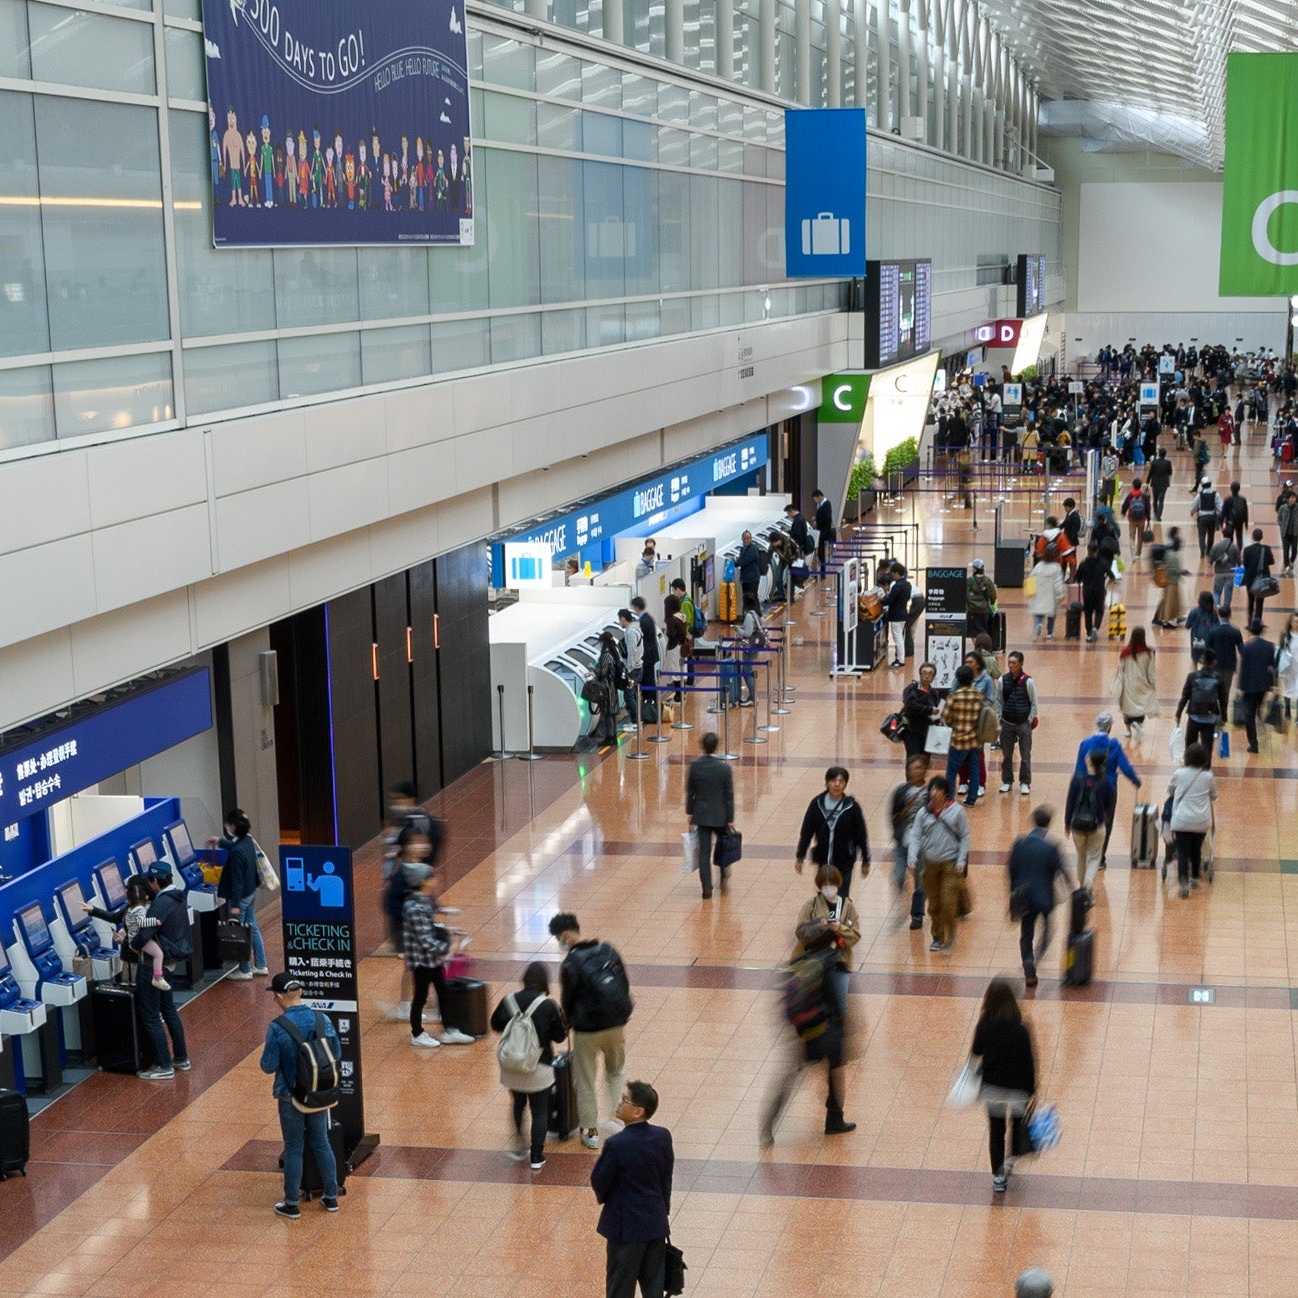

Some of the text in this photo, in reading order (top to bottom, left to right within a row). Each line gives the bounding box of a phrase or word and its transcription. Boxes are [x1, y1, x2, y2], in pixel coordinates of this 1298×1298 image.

[285, 31, 315, 78] DAYS
[319, 52, 335, 81] TO
[338, 29, 365, 77] GO!
[405, 58, 421, 75] HELLO
[1000, 326, 1014, 341] D
[833, 385, 852, 411] C
[640, 483, 664, 516] BAGGAGE
[928, 570, 964, 578] BAGGAGE
[286, 923, 350, 938] TICKETING
[338, 939, 351, 951] IN
[289, 969, 319, 979] Ticketing
[325, 970, 344, 978] Check
